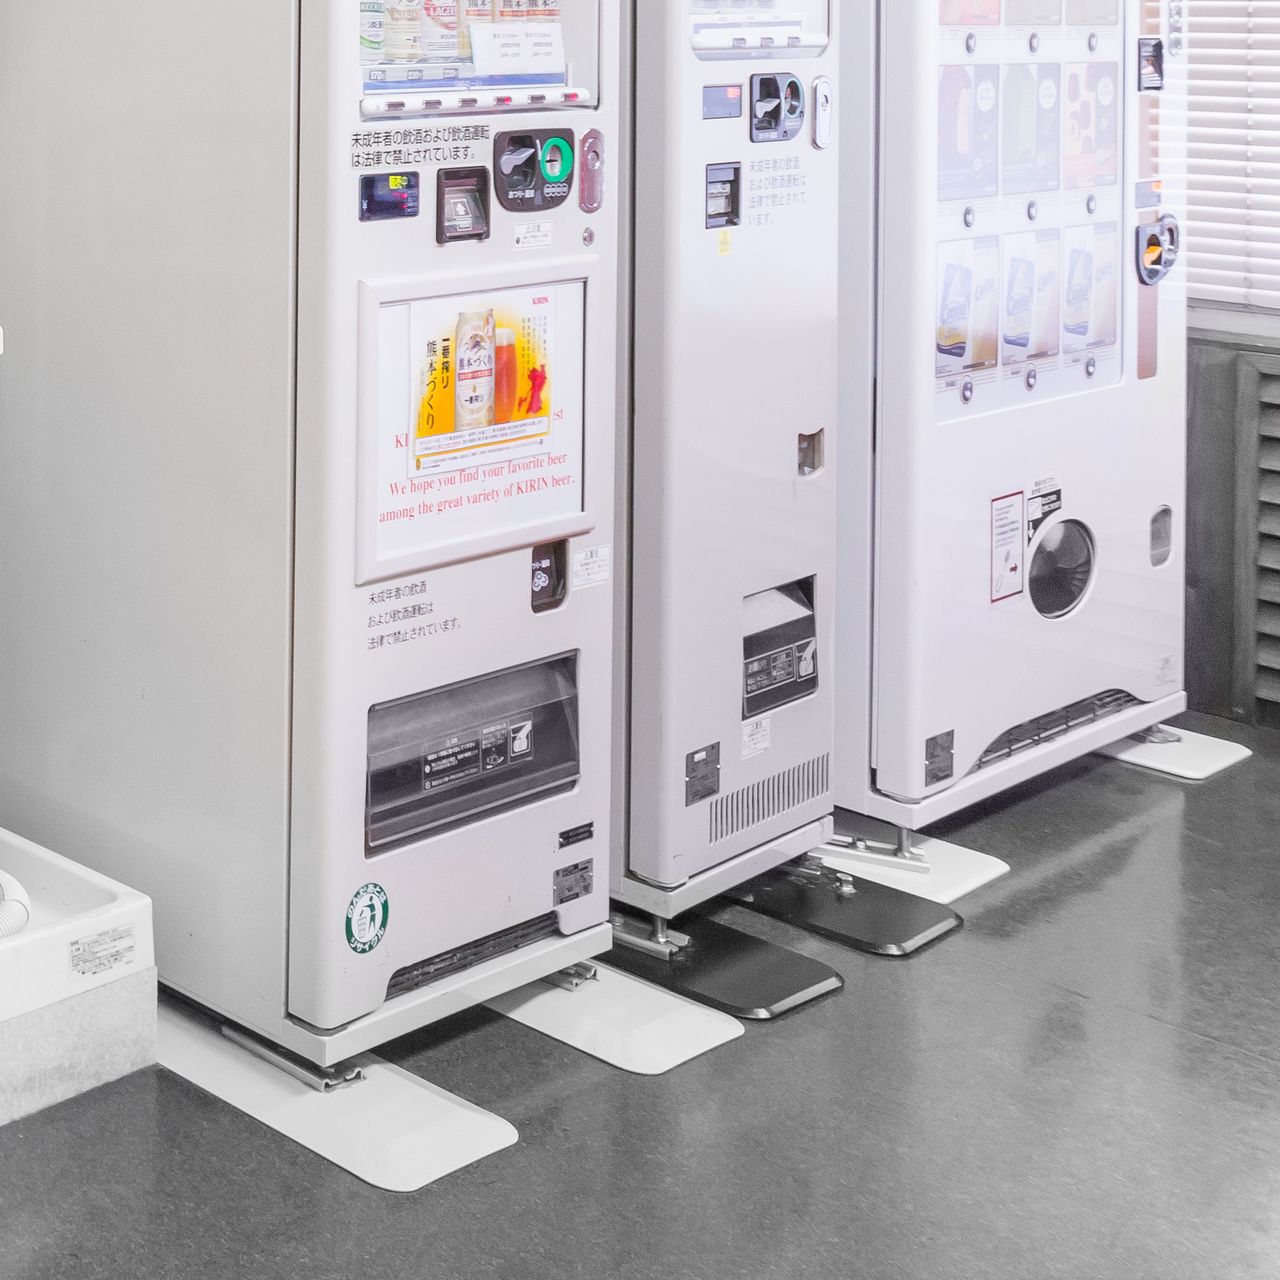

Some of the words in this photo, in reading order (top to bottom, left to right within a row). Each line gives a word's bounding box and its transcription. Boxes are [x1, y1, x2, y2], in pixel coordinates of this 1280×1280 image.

[351, 124, 490, 148] 未成年者の飲酒および飲酒運転
[351, 145, 477, 168] は法律で禁止されています。
[532, 297, 549, 305] KIRIN
[441, 337, 451, 390] 一番搾り
[426, 339, 437, 430] 熊本づくり
[389, 482, 407, 497] We
[410, 476, 434, 498] hope
[437, 475, 456, 490] you
[459, 466, 479, 483] find
[482, 466, 504, 483] your
[508, 455, 545, 475] favorite
[548, 452, 568, 467] beer
[379, 505, 415, 524] among
[418, 499, 434, 515] the
[437, 495, 463, 513] great
[466, 487, 500, 506] variety
[503, 483, 514, 497] of
[516, 478, 549, 496] KIRIN
[368, 580, 428, 606] 未成年者の飲酒
